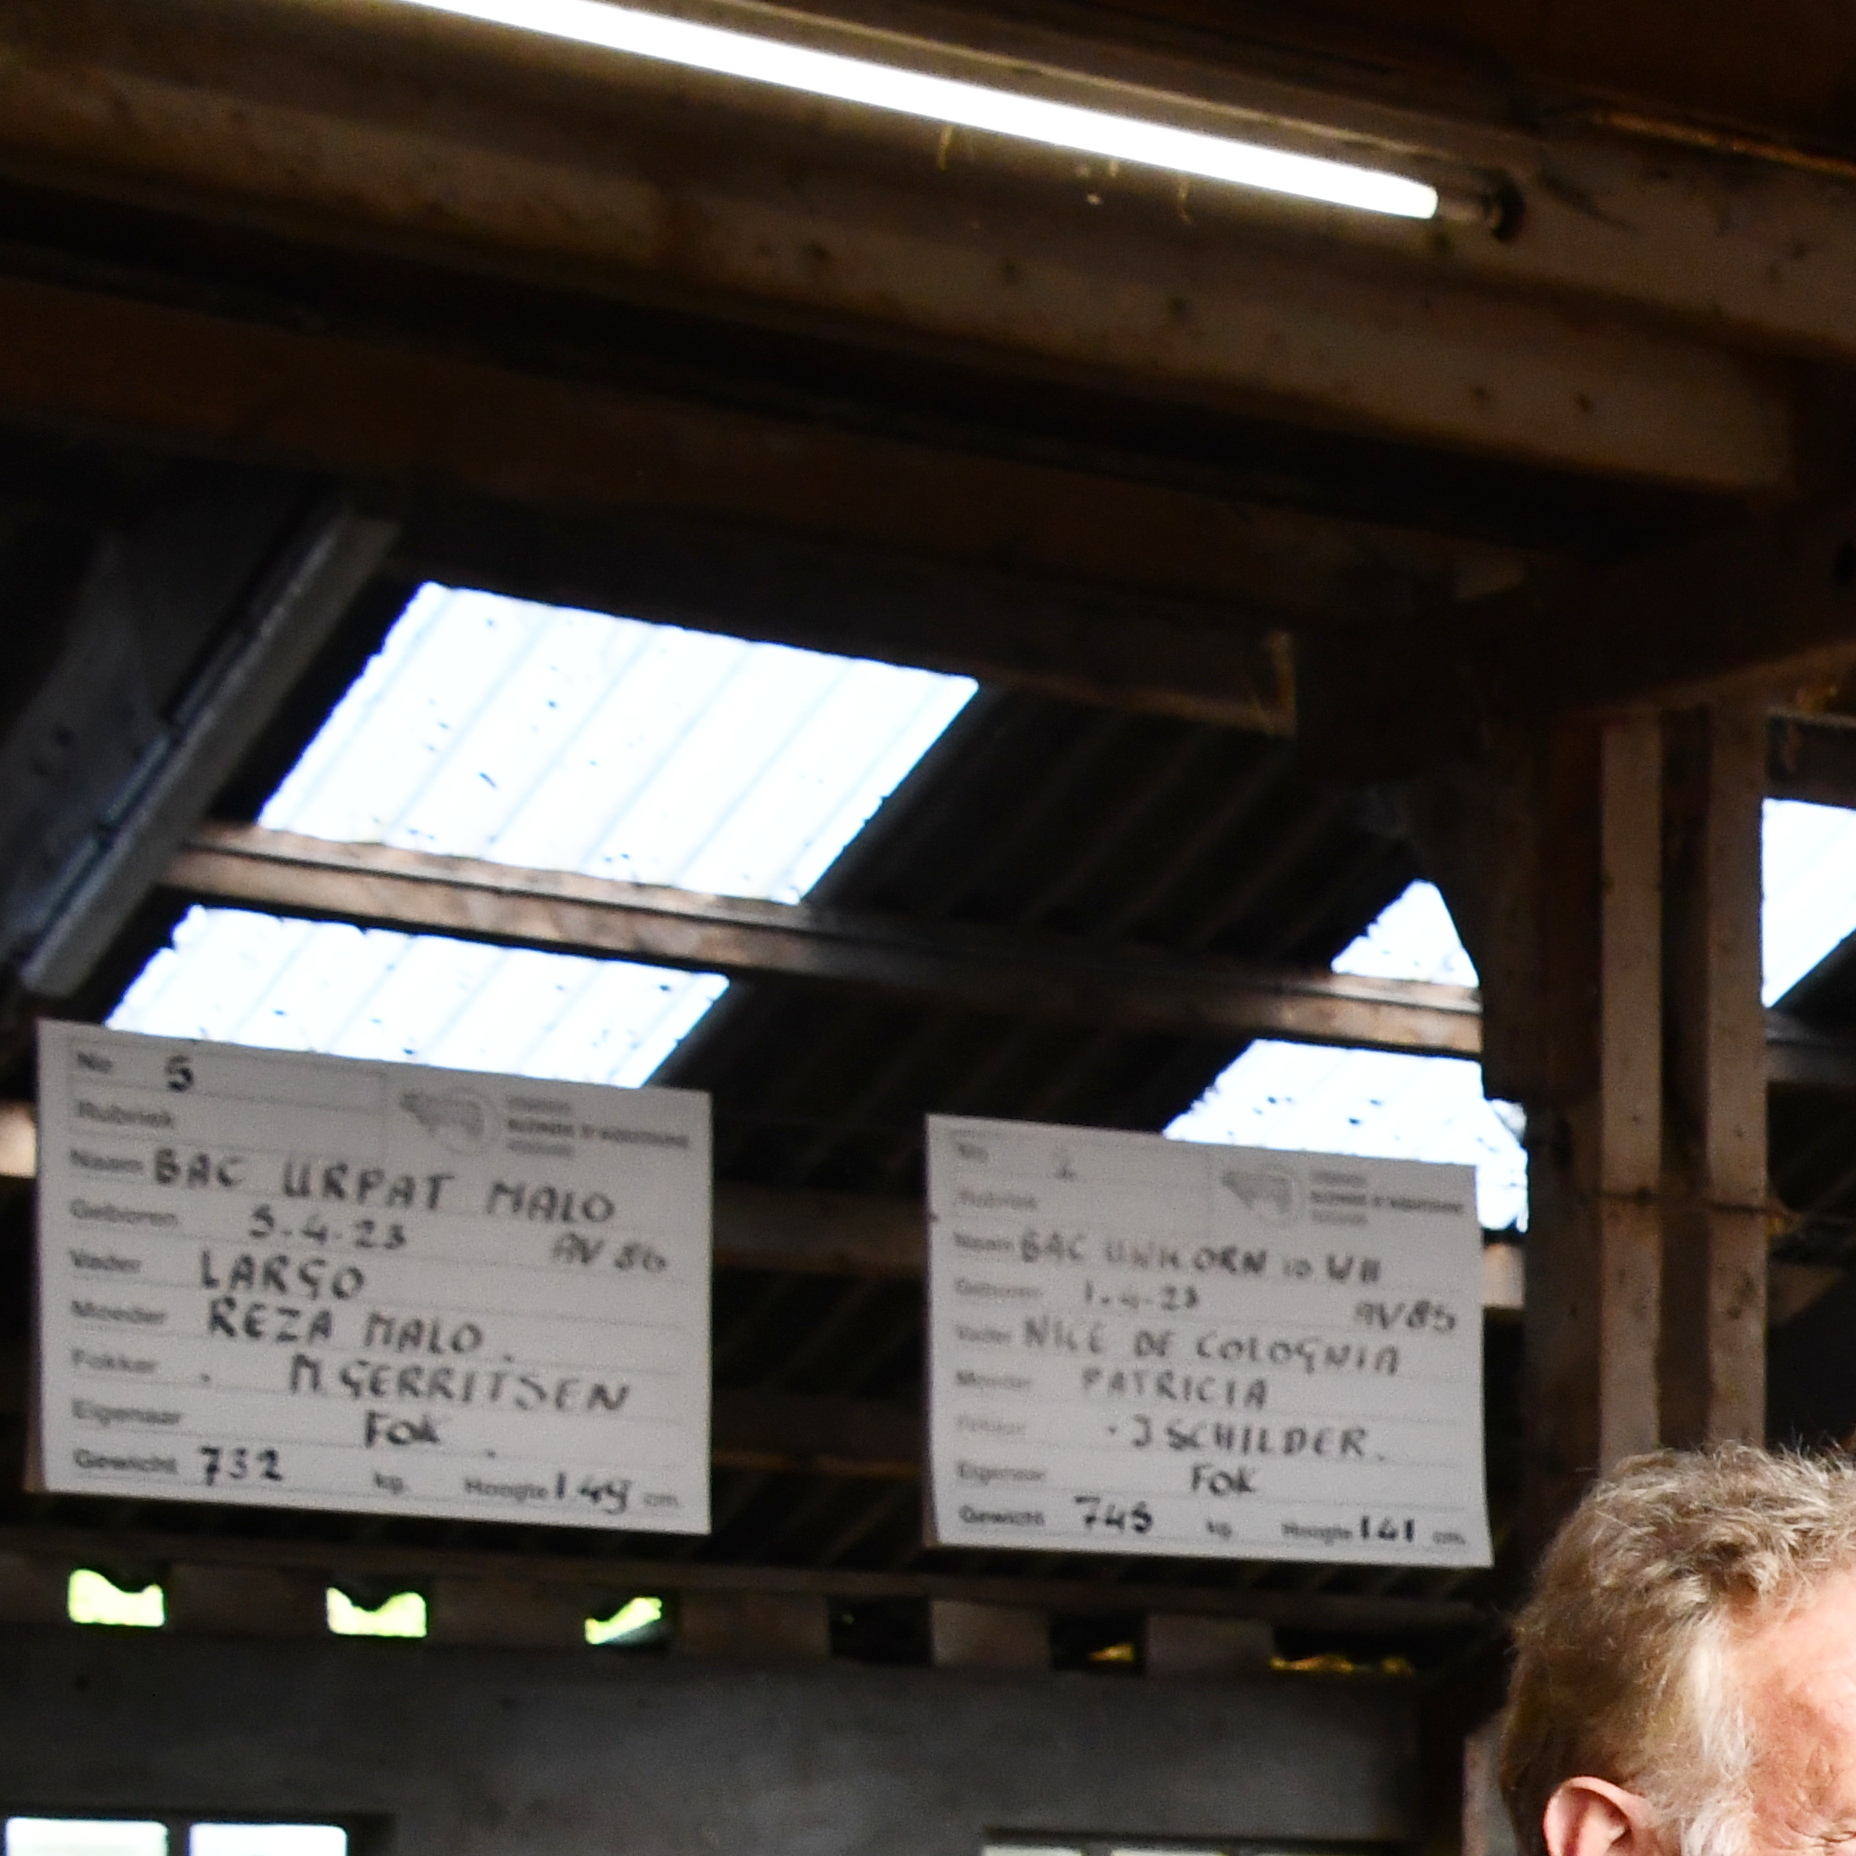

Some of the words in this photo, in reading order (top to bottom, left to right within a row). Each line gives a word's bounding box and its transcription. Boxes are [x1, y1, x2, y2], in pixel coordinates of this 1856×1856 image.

[166, 1054, 194, 1092] 5
[155, 1147, 243, 1187] BAC
[486, 1180, 615, 1223] MALO
[208, 1296, 332, 1344] REZA
[364, 1312, 484, 1355] MALO
[1082, 1367, 1267, 1410] PATRICIA
